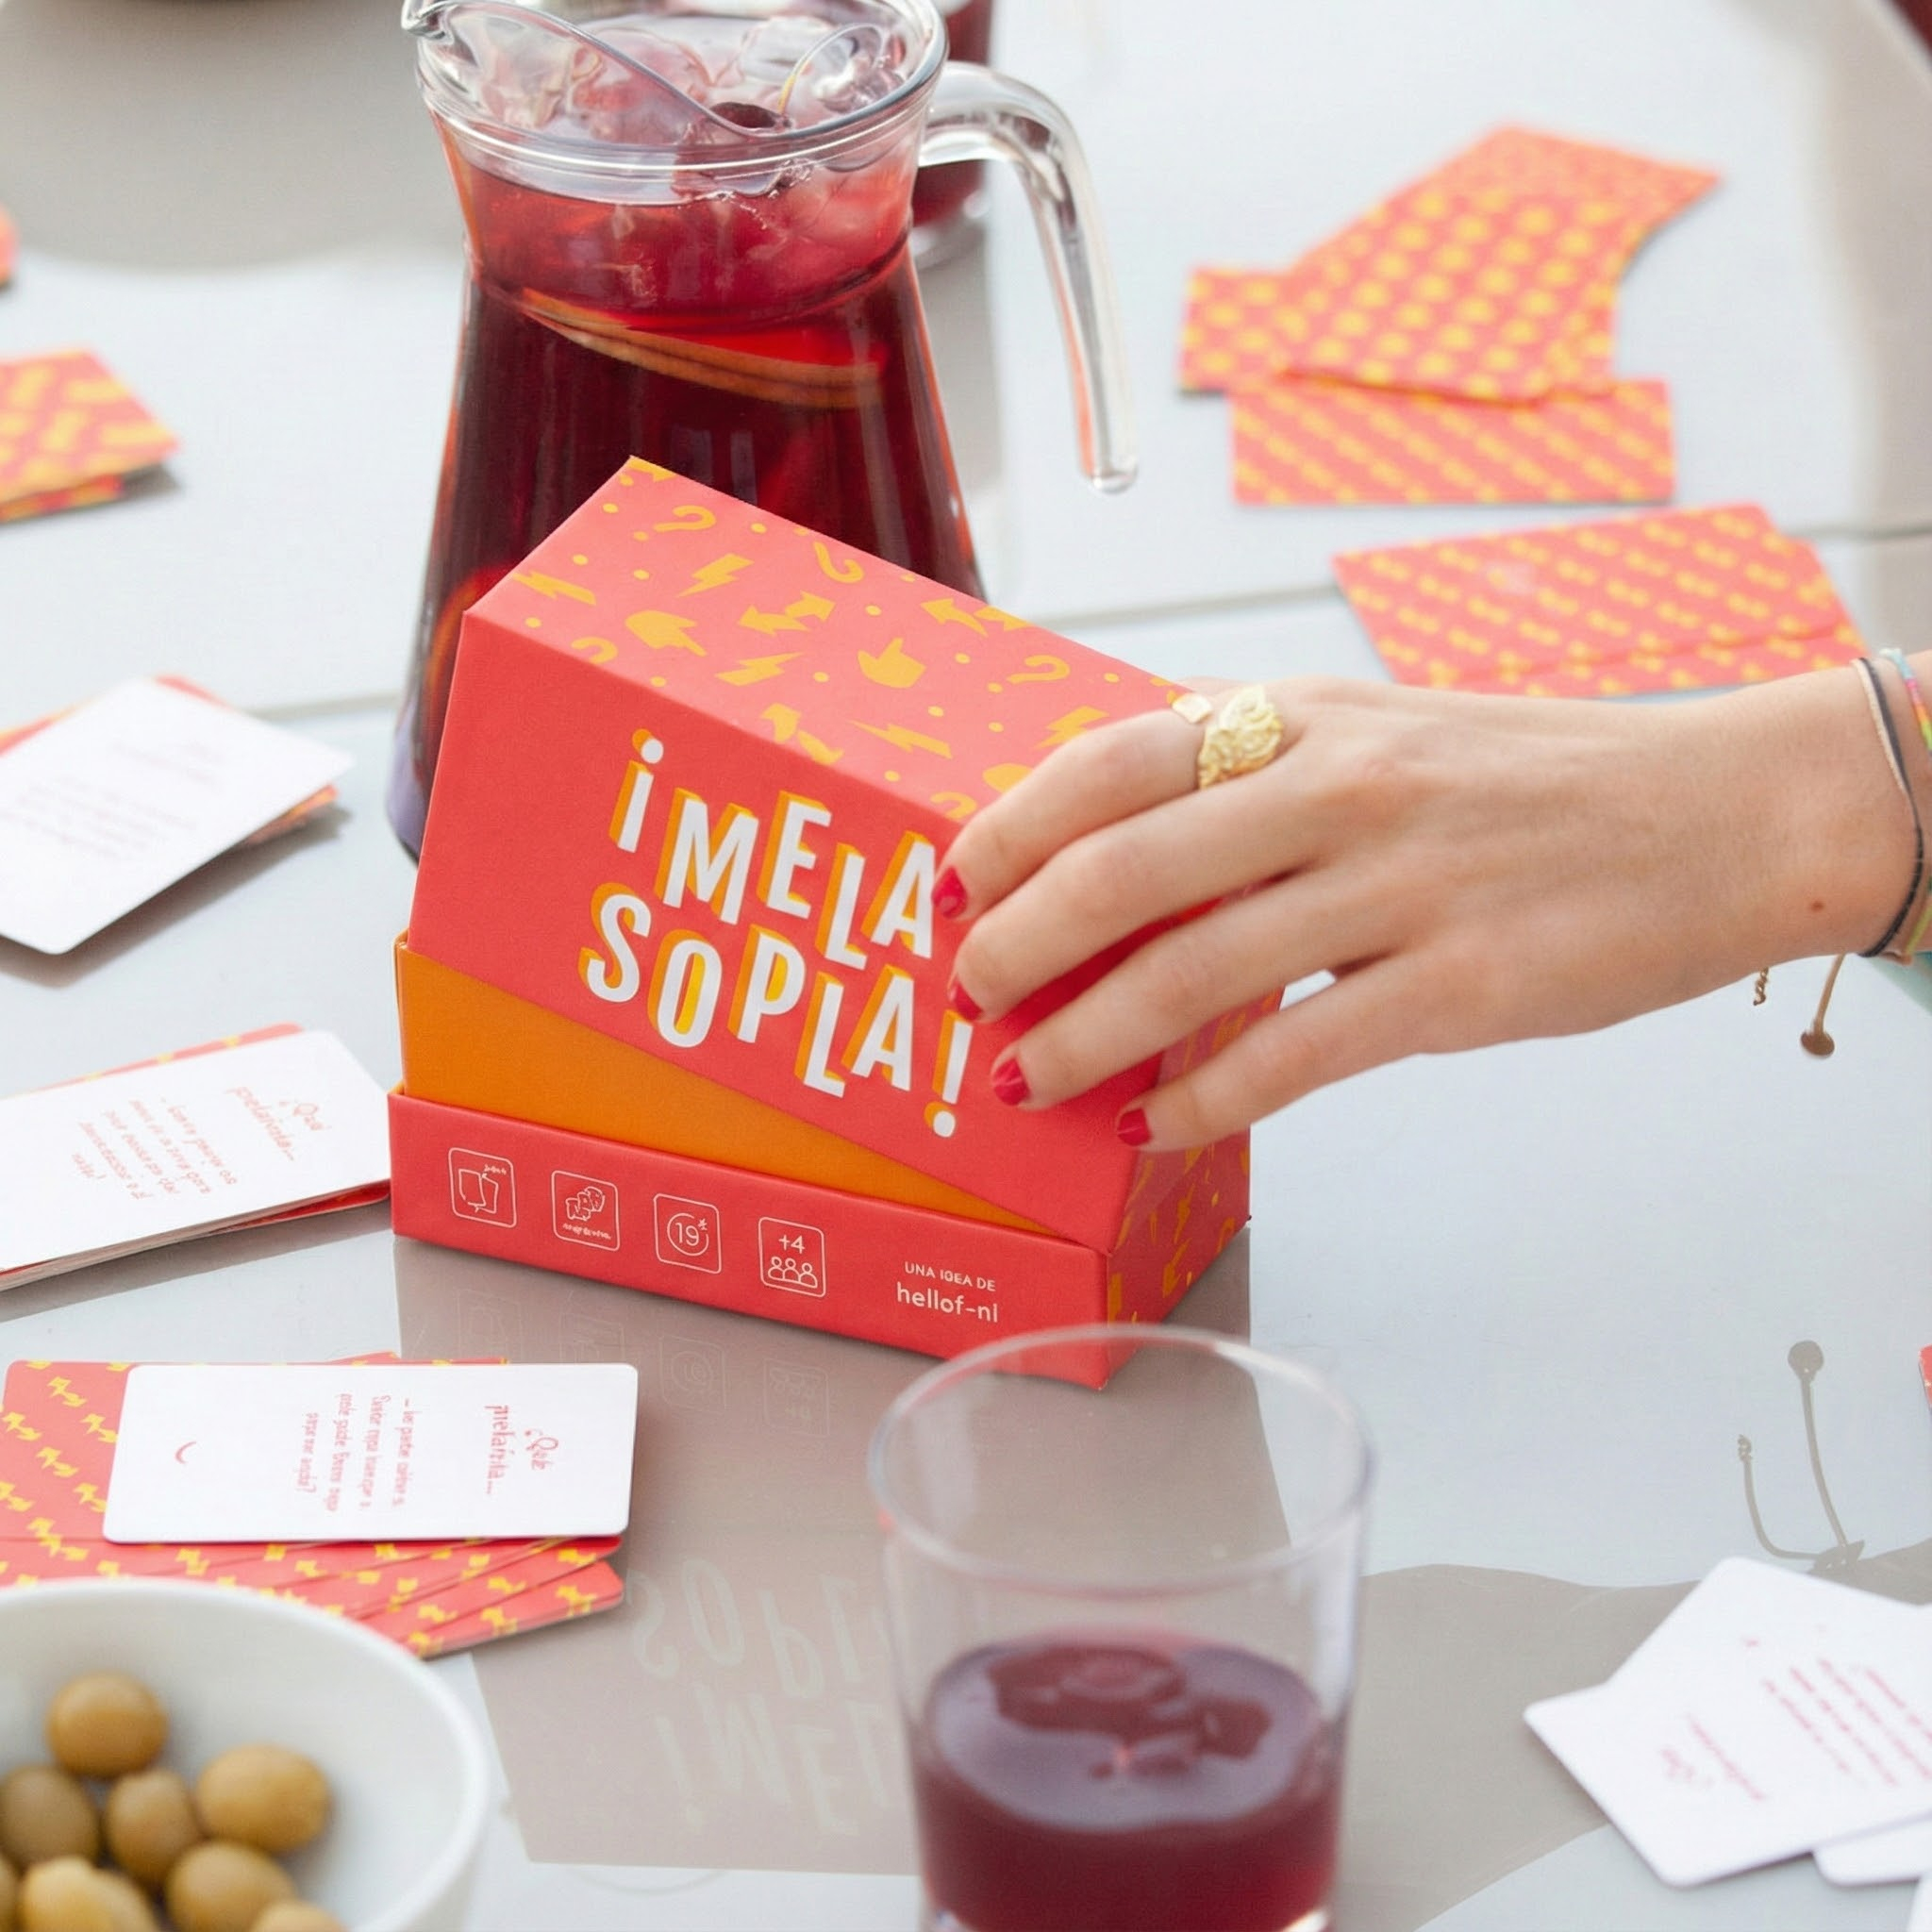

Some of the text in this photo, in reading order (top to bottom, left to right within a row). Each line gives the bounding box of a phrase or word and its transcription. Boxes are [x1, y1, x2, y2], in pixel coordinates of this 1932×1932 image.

[778, 1234, 806, 1255] +4
[904, 1260, 936, 1279] UNA
[976, 1276, 996, 1291] DE
